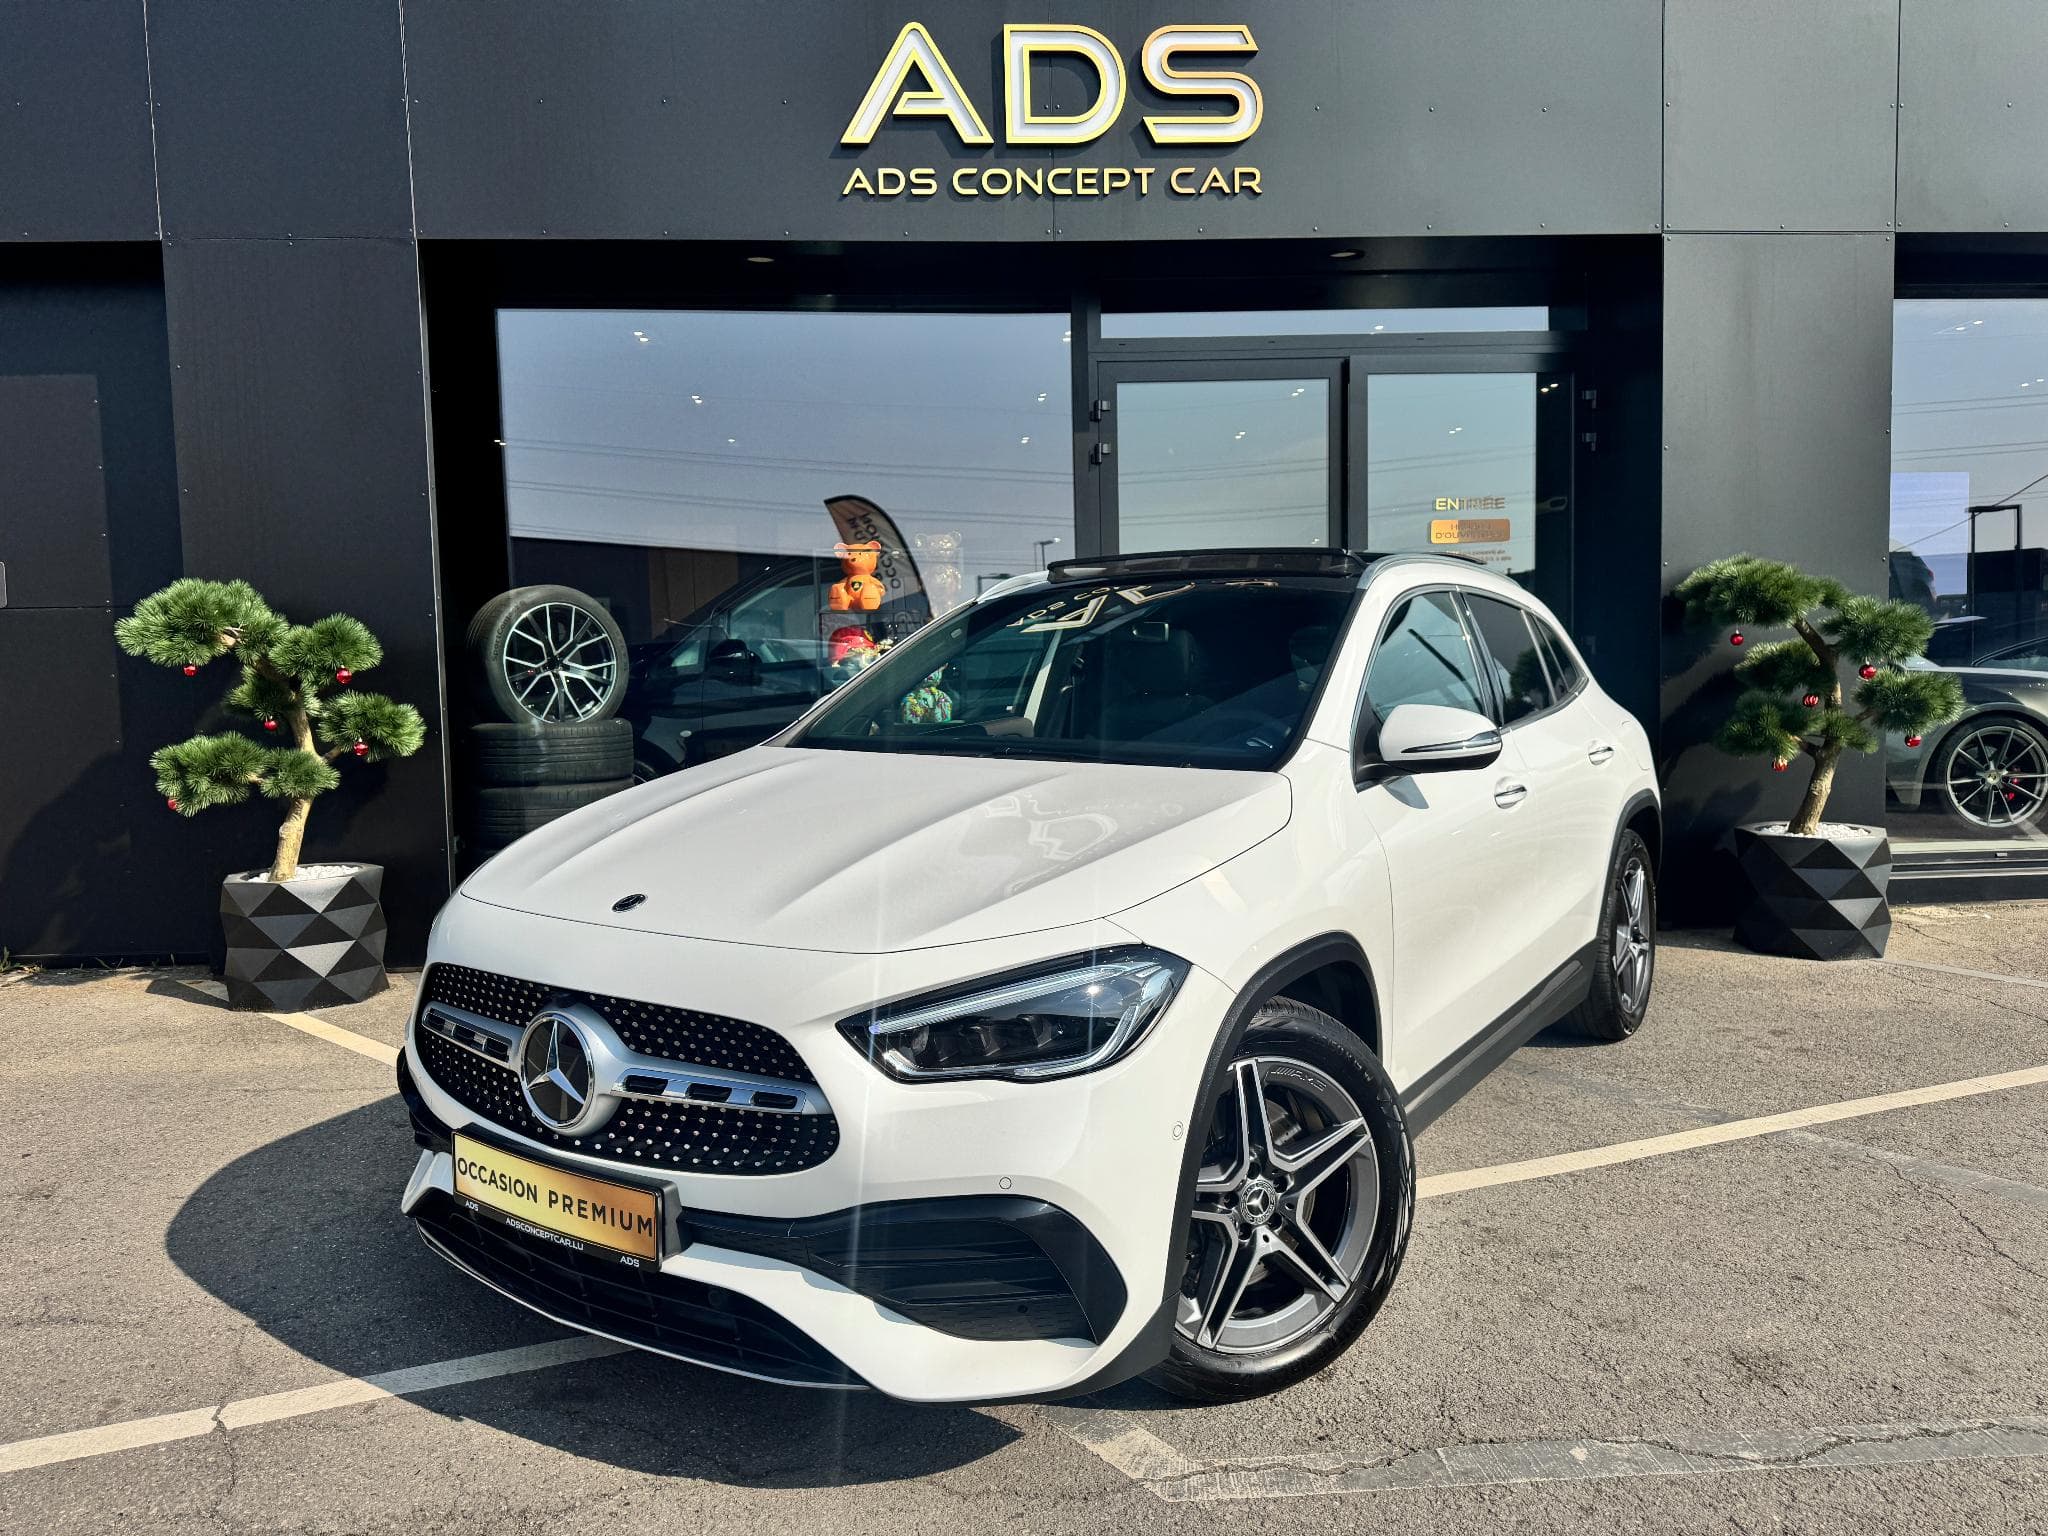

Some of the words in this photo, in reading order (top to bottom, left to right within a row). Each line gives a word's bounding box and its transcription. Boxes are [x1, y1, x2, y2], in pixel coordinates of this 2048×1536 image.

[840, 21, 1264, 144] ADS
[841, 167, 938, 195] ADS
[952, 167, 1156, 195] CONCEPT
[1169, 167, 1264, 195] CAR
[457, 1157, 538, 1203] OCCASION
[548, 1190, 653, 1237] PREMIUM
[465, 1200, 479, 1212] ADS
[505, 1216, 584, 1251] ADSCONCEPTCAR.LU
[620, 1255, 640, 1268] ADS
